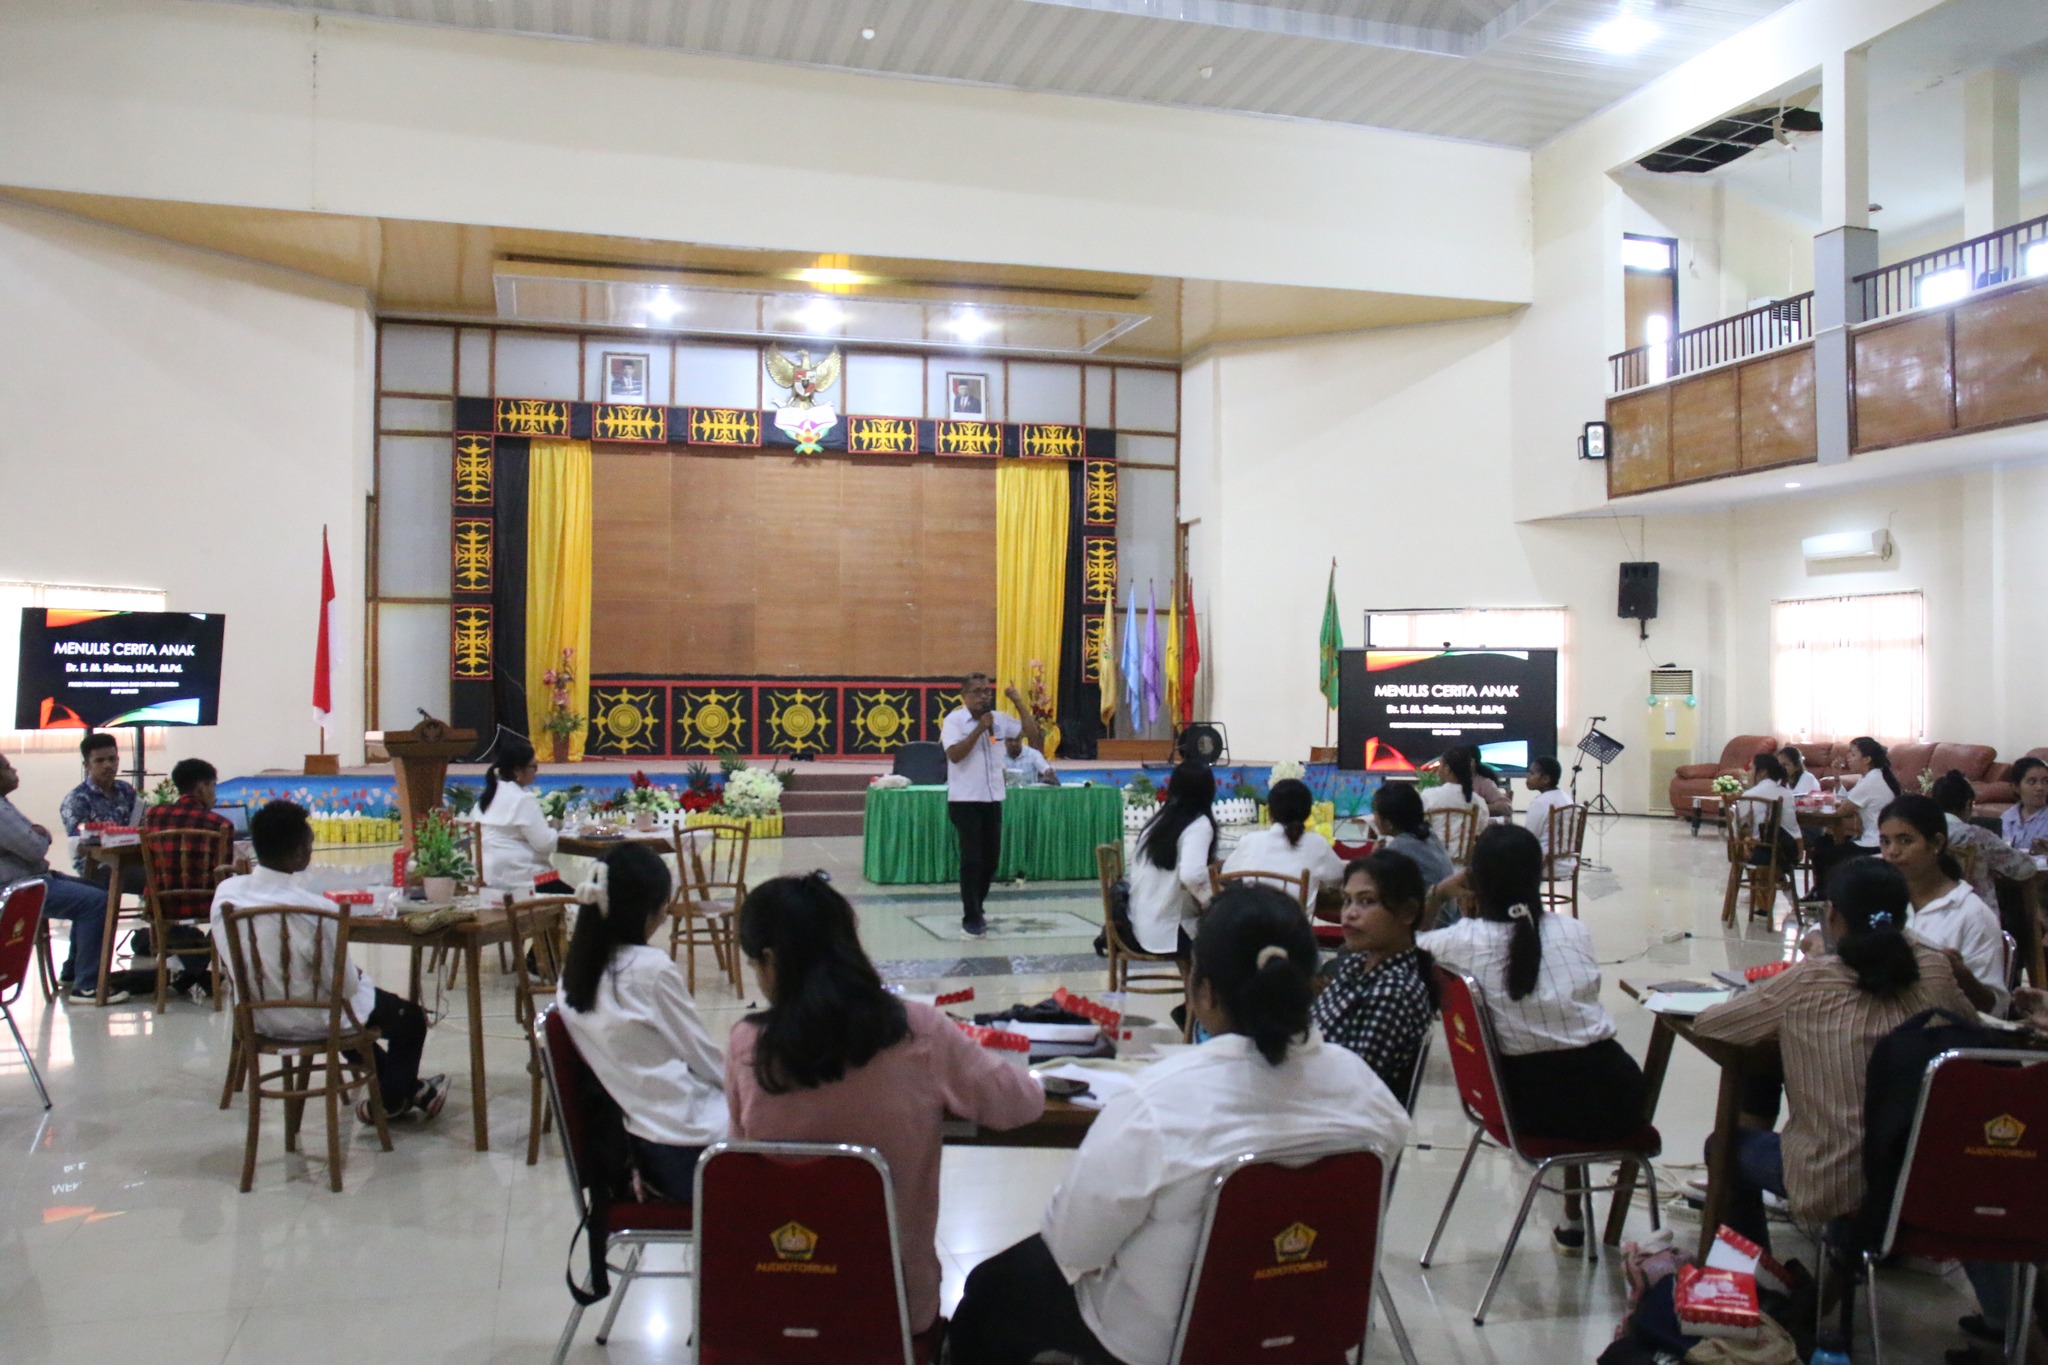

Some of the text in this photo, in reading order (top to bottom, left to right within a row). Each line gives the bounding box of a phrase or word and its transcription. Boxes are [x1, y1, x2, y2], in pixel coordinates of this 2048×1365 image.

[53, 642, 195, 656] MENULIS CERITA ANAK
[66, 663, 79, 672] Dr.
[89, 663, 102, 672] M.
[1374, 684, 1520, 698] MENULIS CERITA ANAK
[1386, 704, 1400, 714] Dr.
